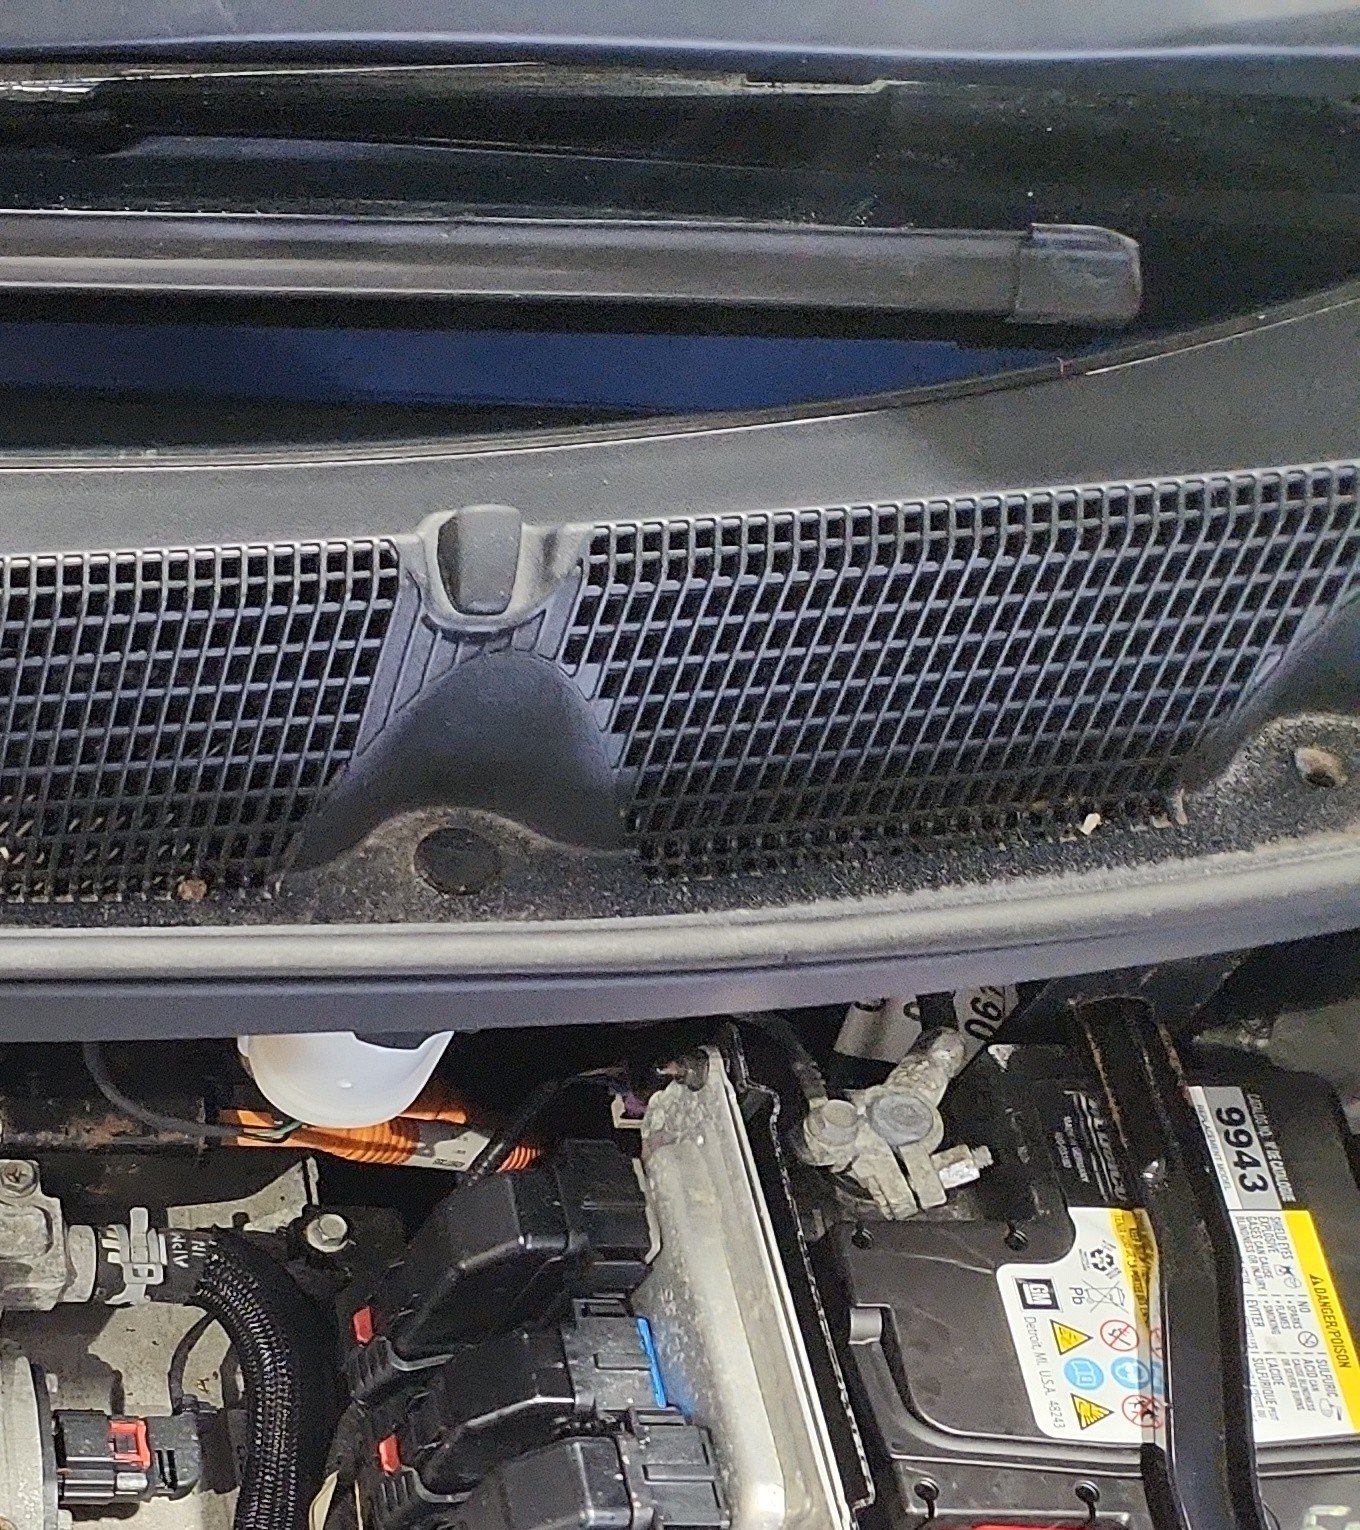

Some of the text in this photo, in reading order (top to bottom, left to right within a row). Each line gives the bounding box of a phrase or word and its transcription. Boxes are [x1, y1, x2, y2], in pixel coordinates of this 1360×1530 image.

[1216, 1107, 1269, 1193] 9943
[1216, 1162, 1232, 1192] MODEL
[1278, 1242, 1294, 1260] EYES
[1070, 1286, 1086, 1306] Pb
[1297, 1300, 1311, 1313] NO
[1314, 1287, 1351, 1368] DANGER/POISON
[1252, 1358, 1277, 1405] SULFURIQUE
[1301, 1358, 1318, 1378] ACID
[1316, 1359, 1338, 1398] SULFURIC
[1049, 1399, 1066, 1429] 48243
